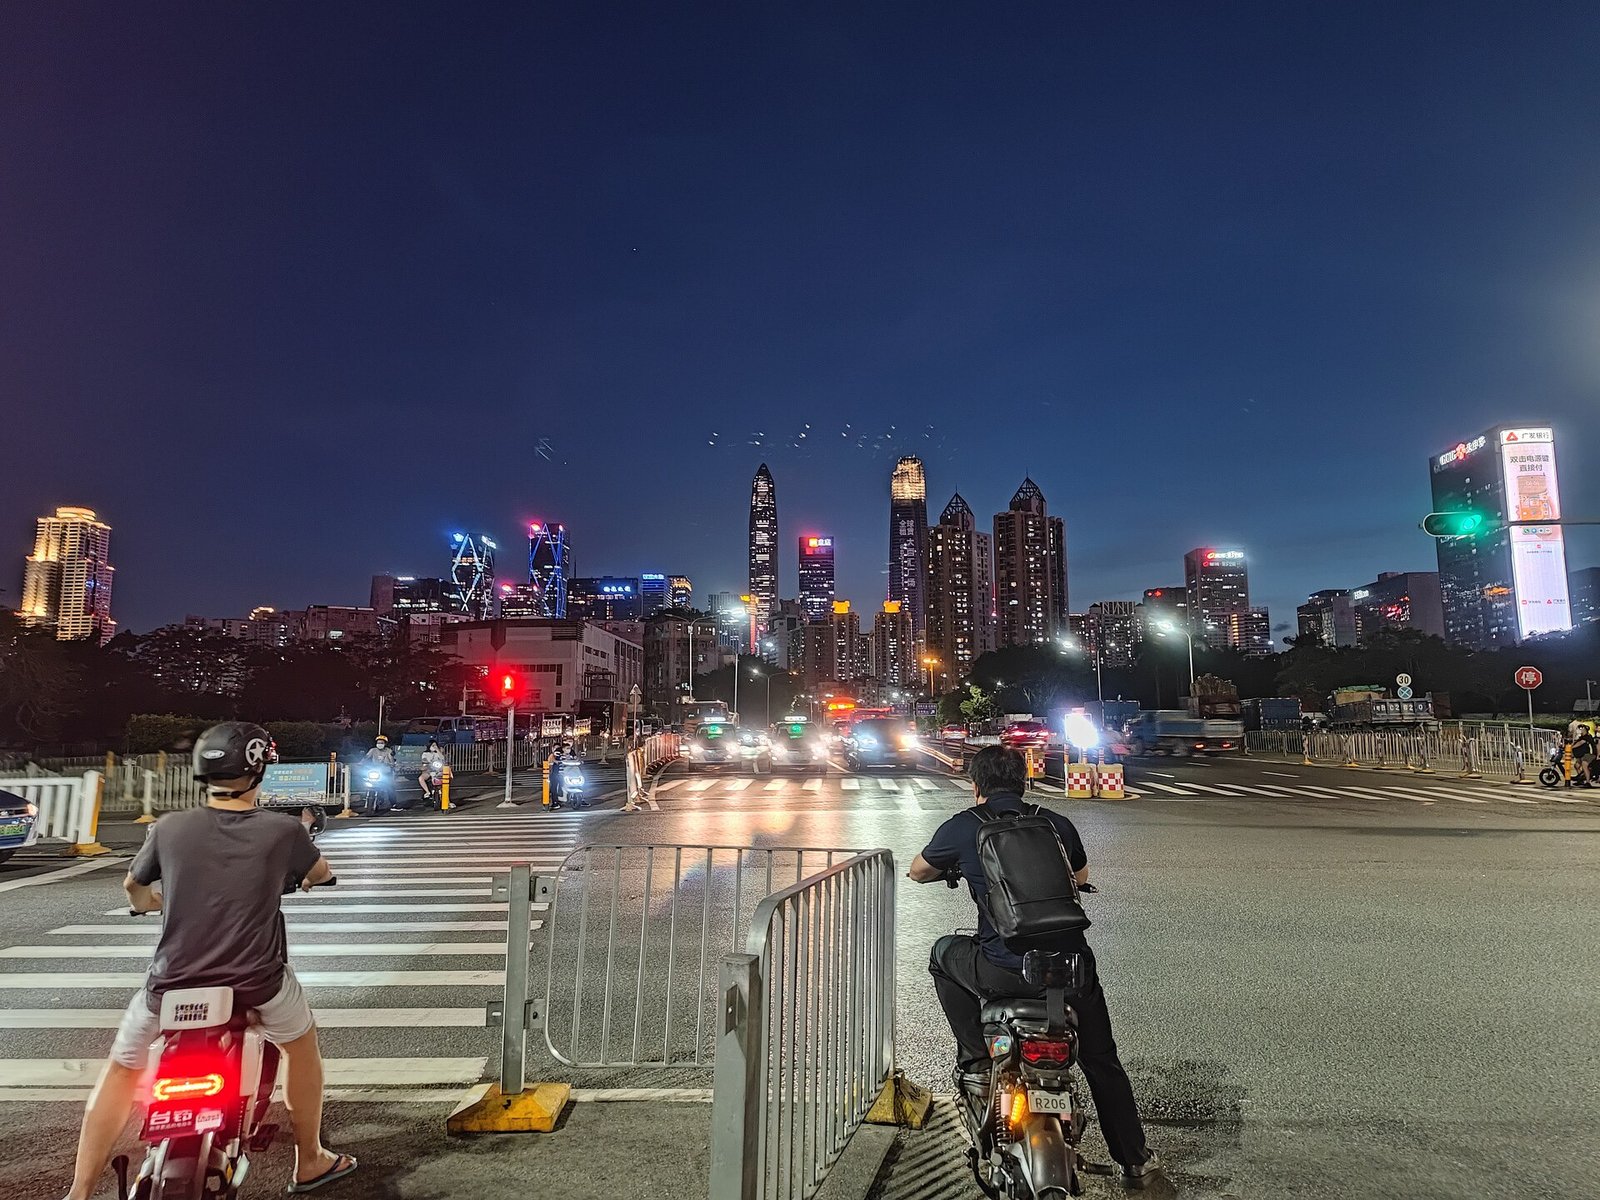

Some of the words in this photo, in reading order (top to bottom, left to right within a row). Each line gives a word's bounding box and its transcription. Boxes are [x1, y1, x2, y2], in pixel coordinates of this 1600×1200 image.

[1521, 431, 1549, 439] 广发银行
[1510, 454, 1550, 463] 双击电源键
[1519, 464, 1543, 472] 直接付
[1398, 675, 1409, 684] 30
[1521, 671, 1537, 684] 停
[1035, 1098, 1066, 1109] R206
